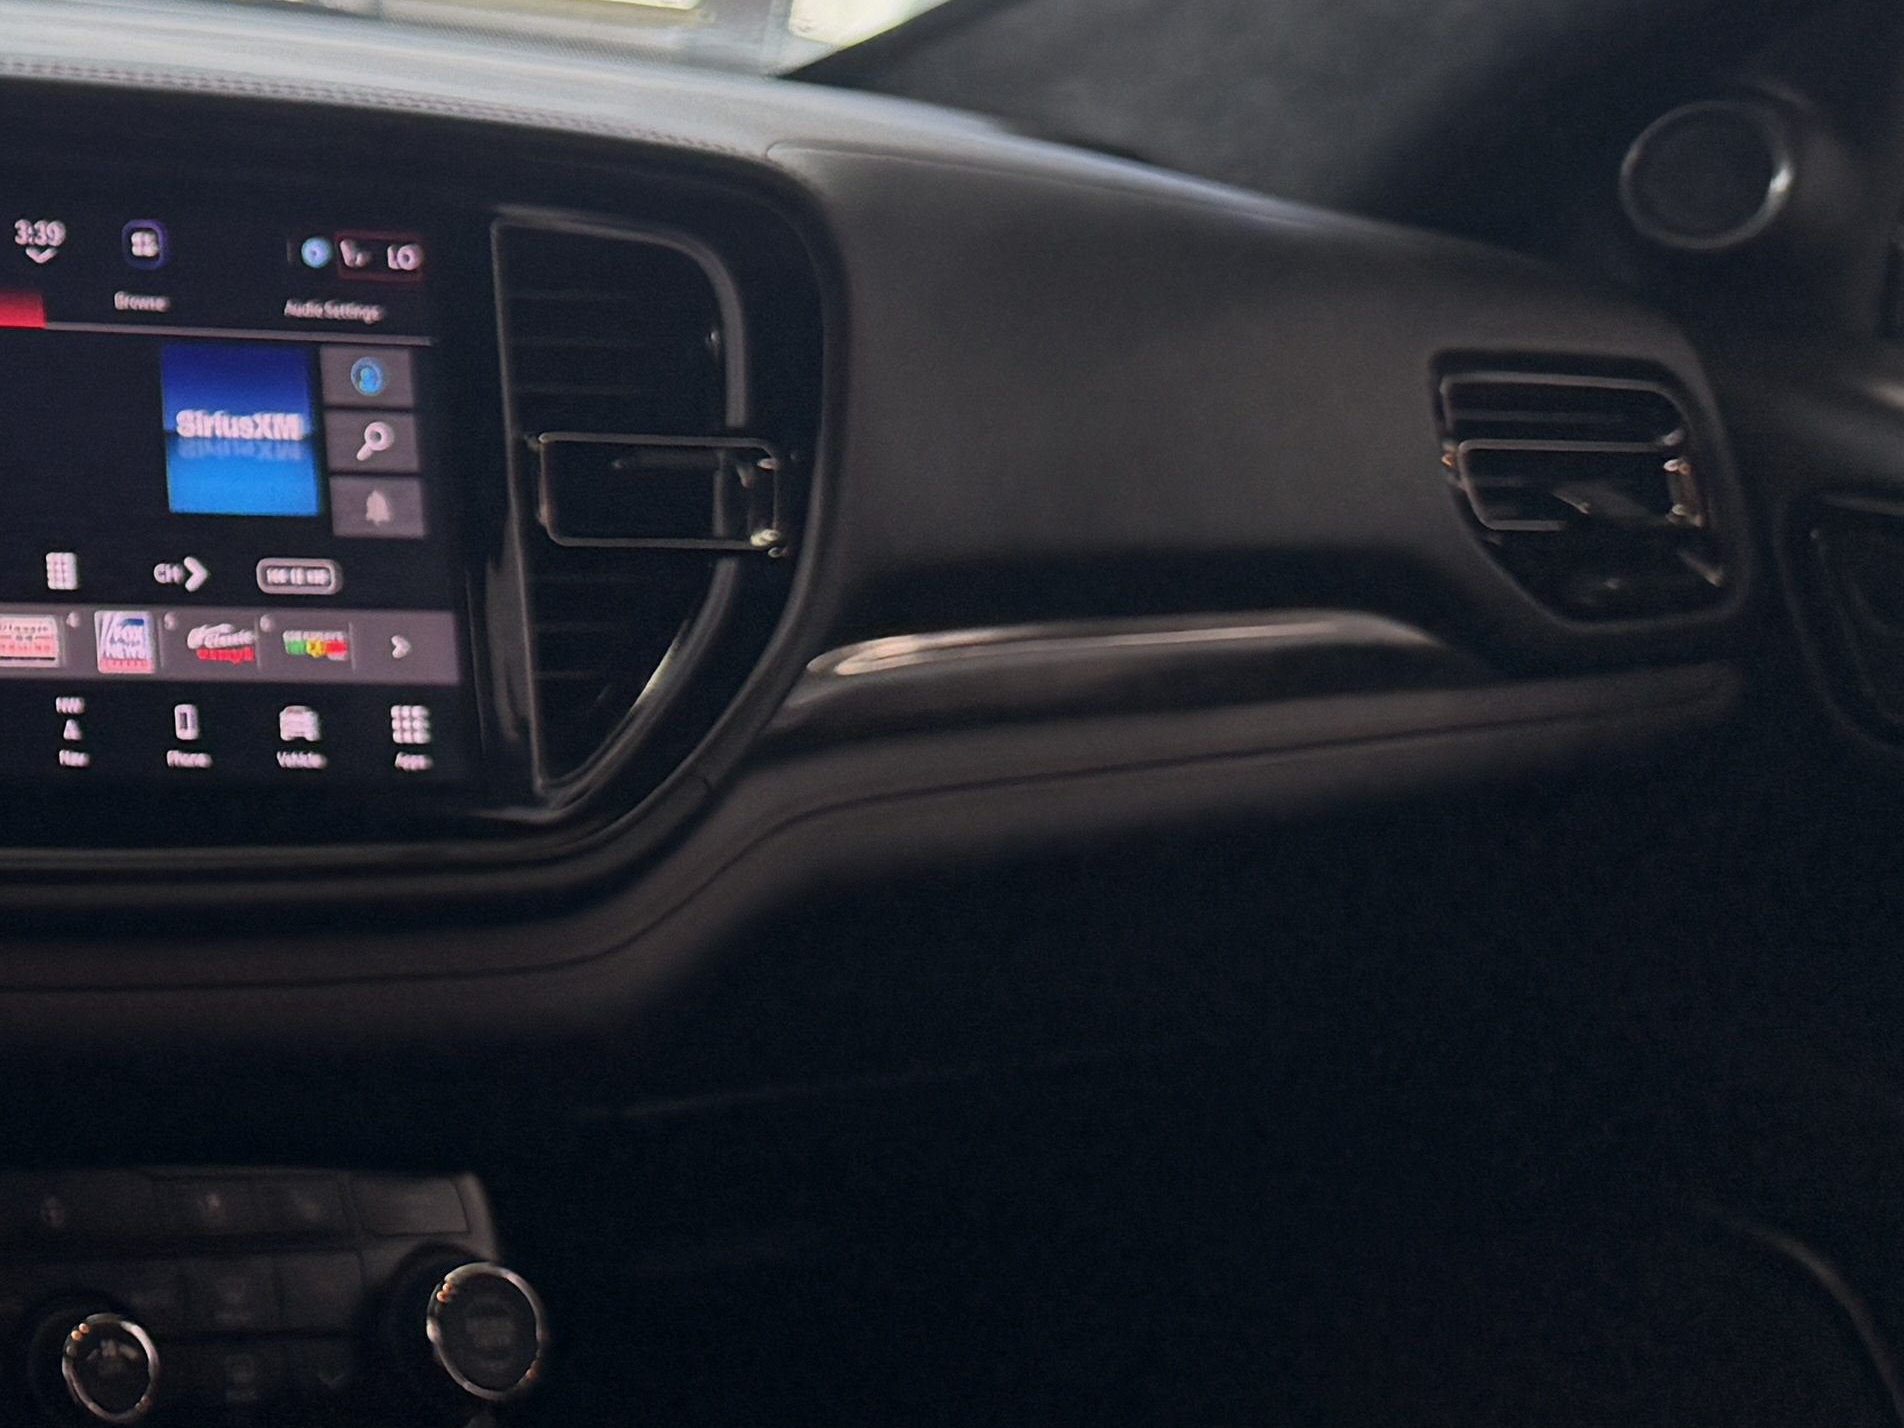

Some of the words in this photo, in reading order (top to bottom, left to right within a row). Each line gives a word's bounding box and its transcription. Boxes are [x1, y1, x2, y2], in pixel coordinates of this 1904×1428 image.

[14, 219, 67, 247] 3:39
[387, 242, 423, 270] LO
[114, 291, 171, 313] Browse
[284, 298, 323, 320] Audio
[323, 300, 385, 325] Settings
[176, 409, 306, 441] SiriusXM
[153, 562, 185, 584] CH
[59, 749, 91, 768] Nav
[166, 749, 213, 769] Phone
[276, 750, 327, 770] Vehicle
[394, 751, 433, 772] Apps
